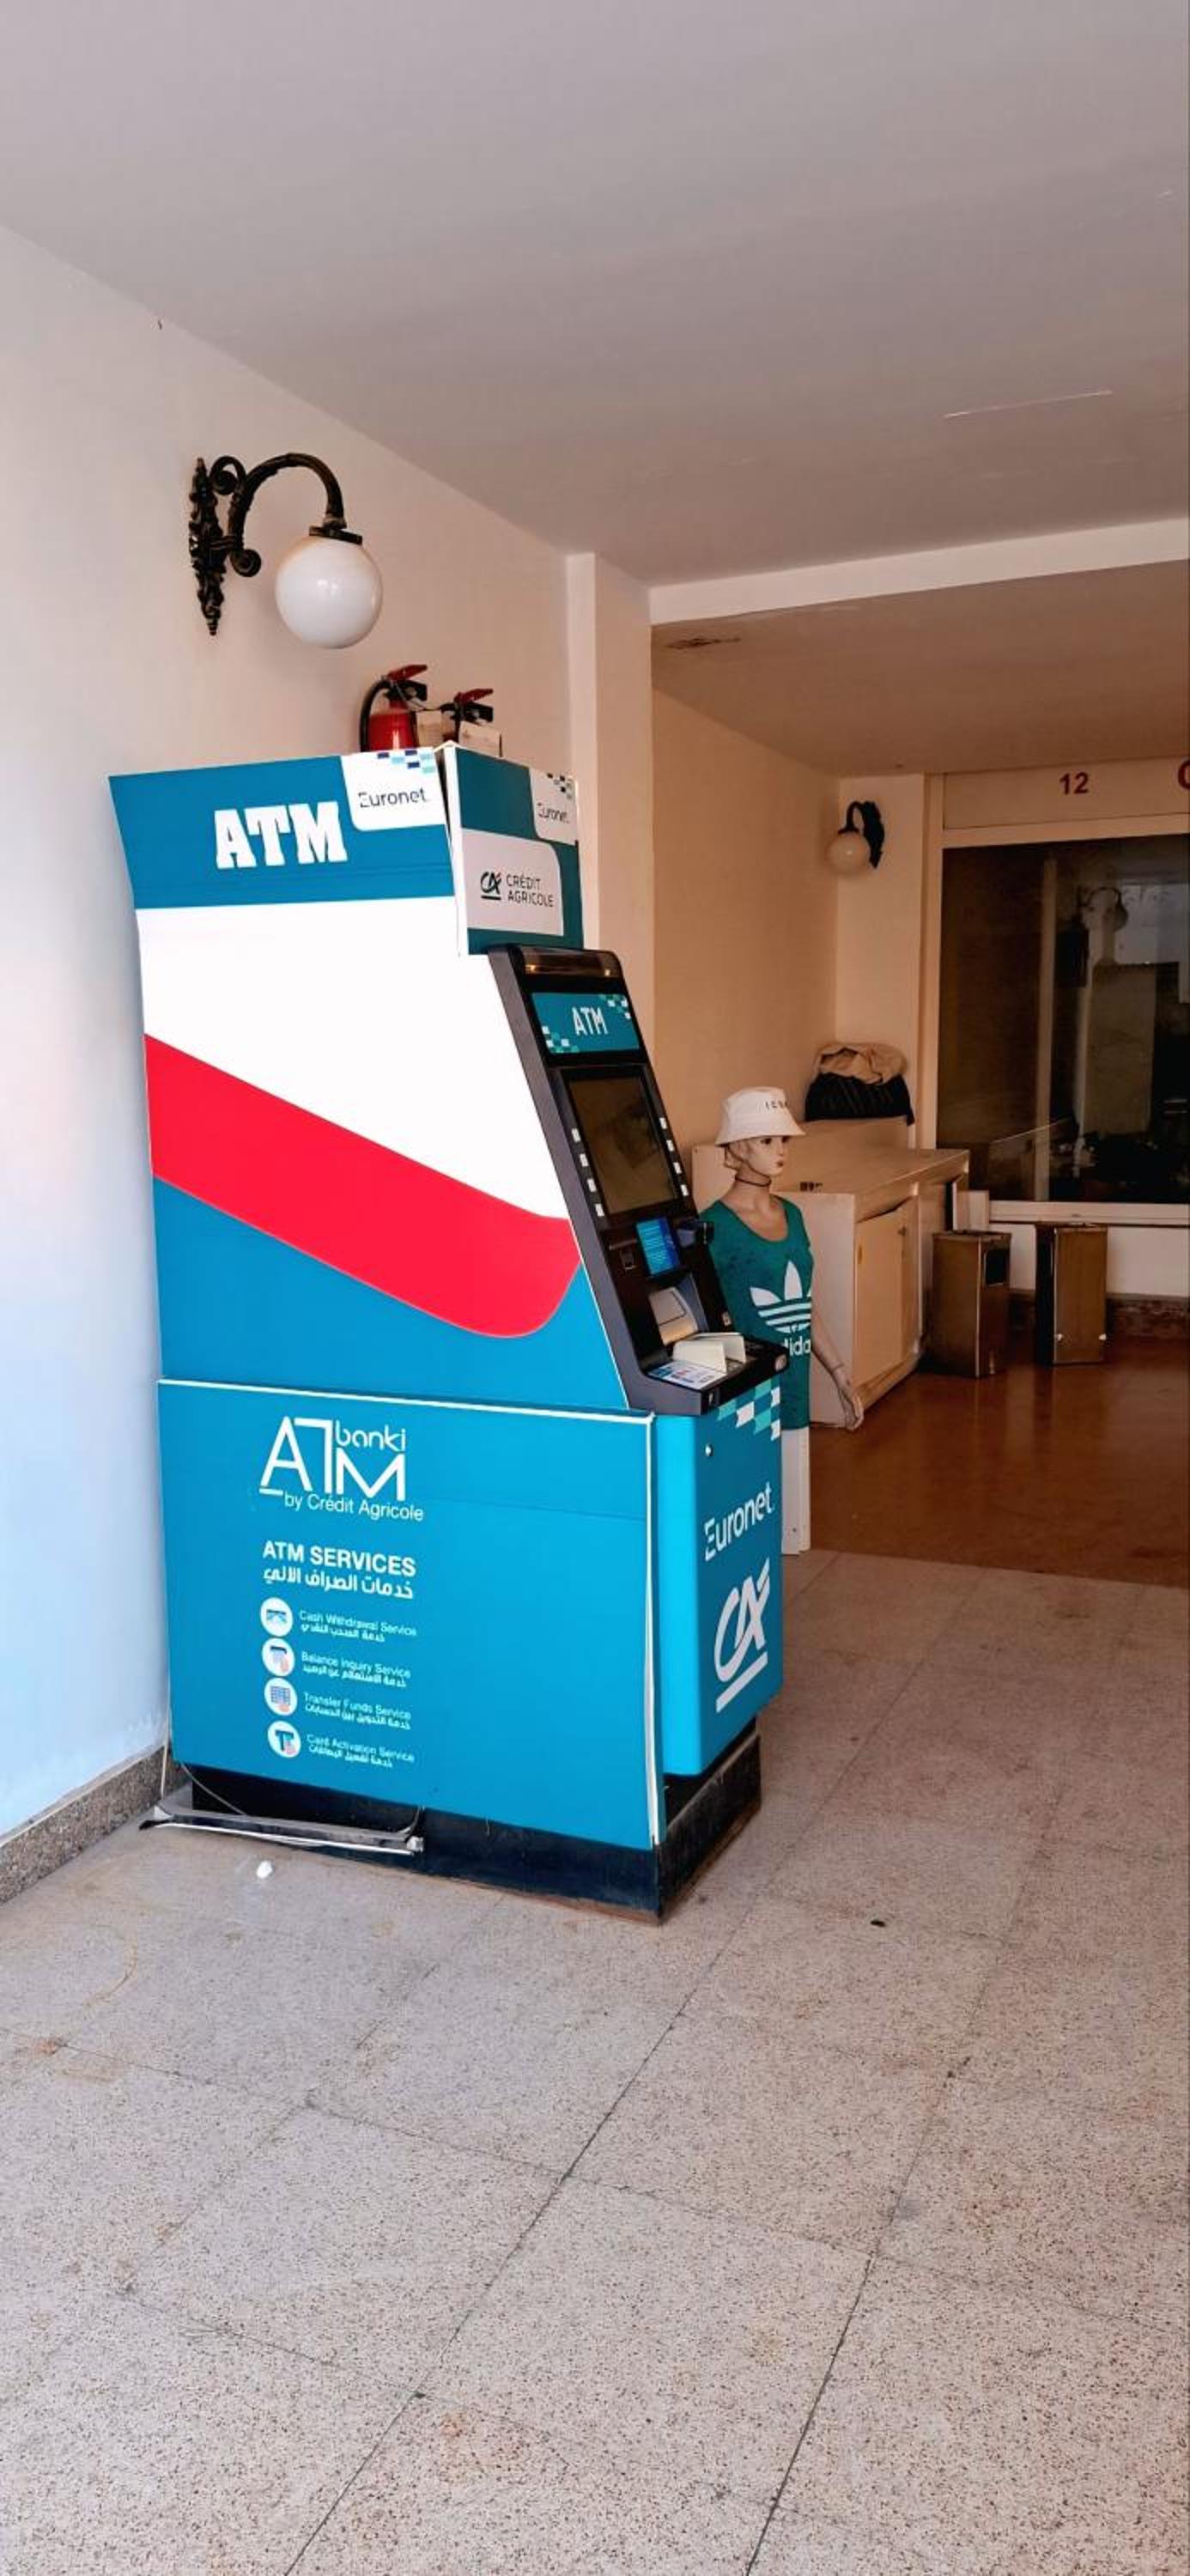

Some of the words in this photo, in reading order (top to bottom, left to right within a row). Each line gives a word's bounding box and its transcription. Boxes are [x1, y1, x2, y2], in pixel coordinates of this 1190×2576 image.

[1059, 772, 1089, 795] 12
[214, 800, 348, 870] ATM
[507, 890, 555, 908] AGRICOLE
[572, 1005, 609, 1036] ATM
[335, 1419, 407, 1452] banki
[284, 1491, 303, 1511] by
[307, 1493, 355, 1514] Crédit
[358, 1500, 425, 1522] Agricole
[263, 1540, 304, 1564] ATM
[310, 1545, 416, 1578] SERVICES
[305, 1569, 359, 1592] الصراف
[361, 1576, 414, 1600] خدمات
[300, 1610, 324, 1623] Cash
[326, 1613, 379, 1631] Withdrawal
[380, 1622, 417, 1637] Service
[302, 1651, 338, 1666] Balance
[341, 1657, 373, 1674] Inquiry
[374, 1662, 411, 1679] Service
[304, 1692, 343, 1707] Transfer
[343, 1699, 373, 1713] Funds
[375, 1704, 411, 1720] Service
[307, 1735, 331, 1746] Card
[331, 1738, 378, 1755] Activation
[379, 1747, 415, 1763] Service
